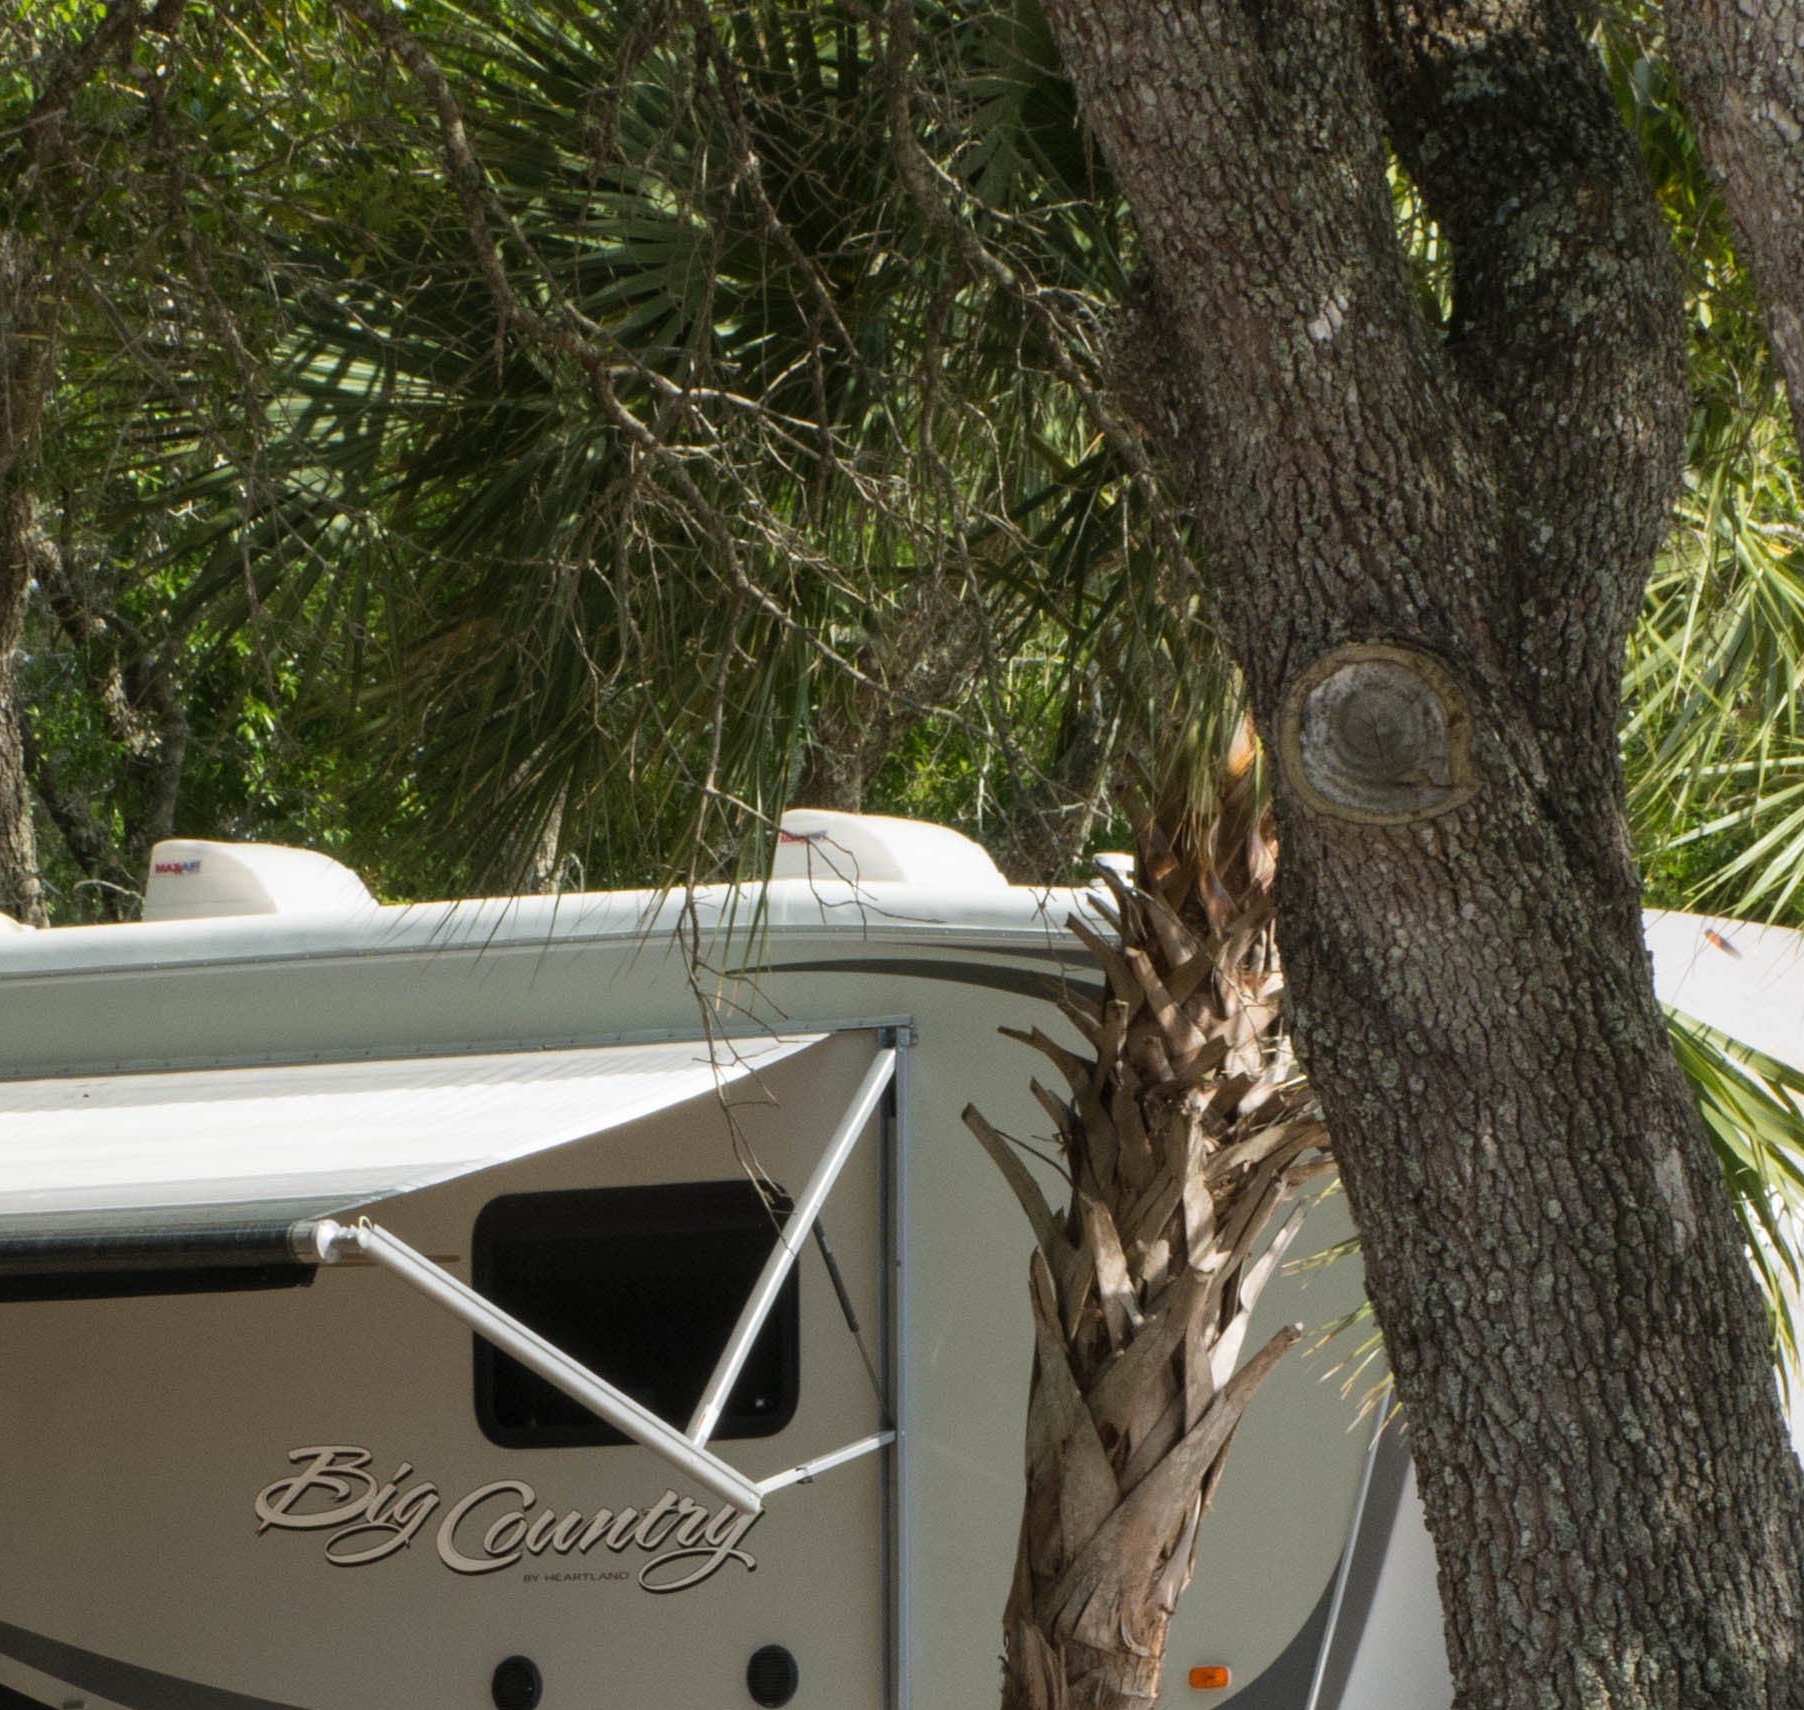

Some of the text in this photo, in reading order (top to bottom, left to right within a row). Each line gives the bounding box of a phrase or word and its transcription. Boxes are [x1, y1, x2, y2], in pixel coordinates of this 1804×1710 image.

[254, 1445, 763, 1593] Big Country
[523, 1571, 629, 1583] BY HEARTLAND
